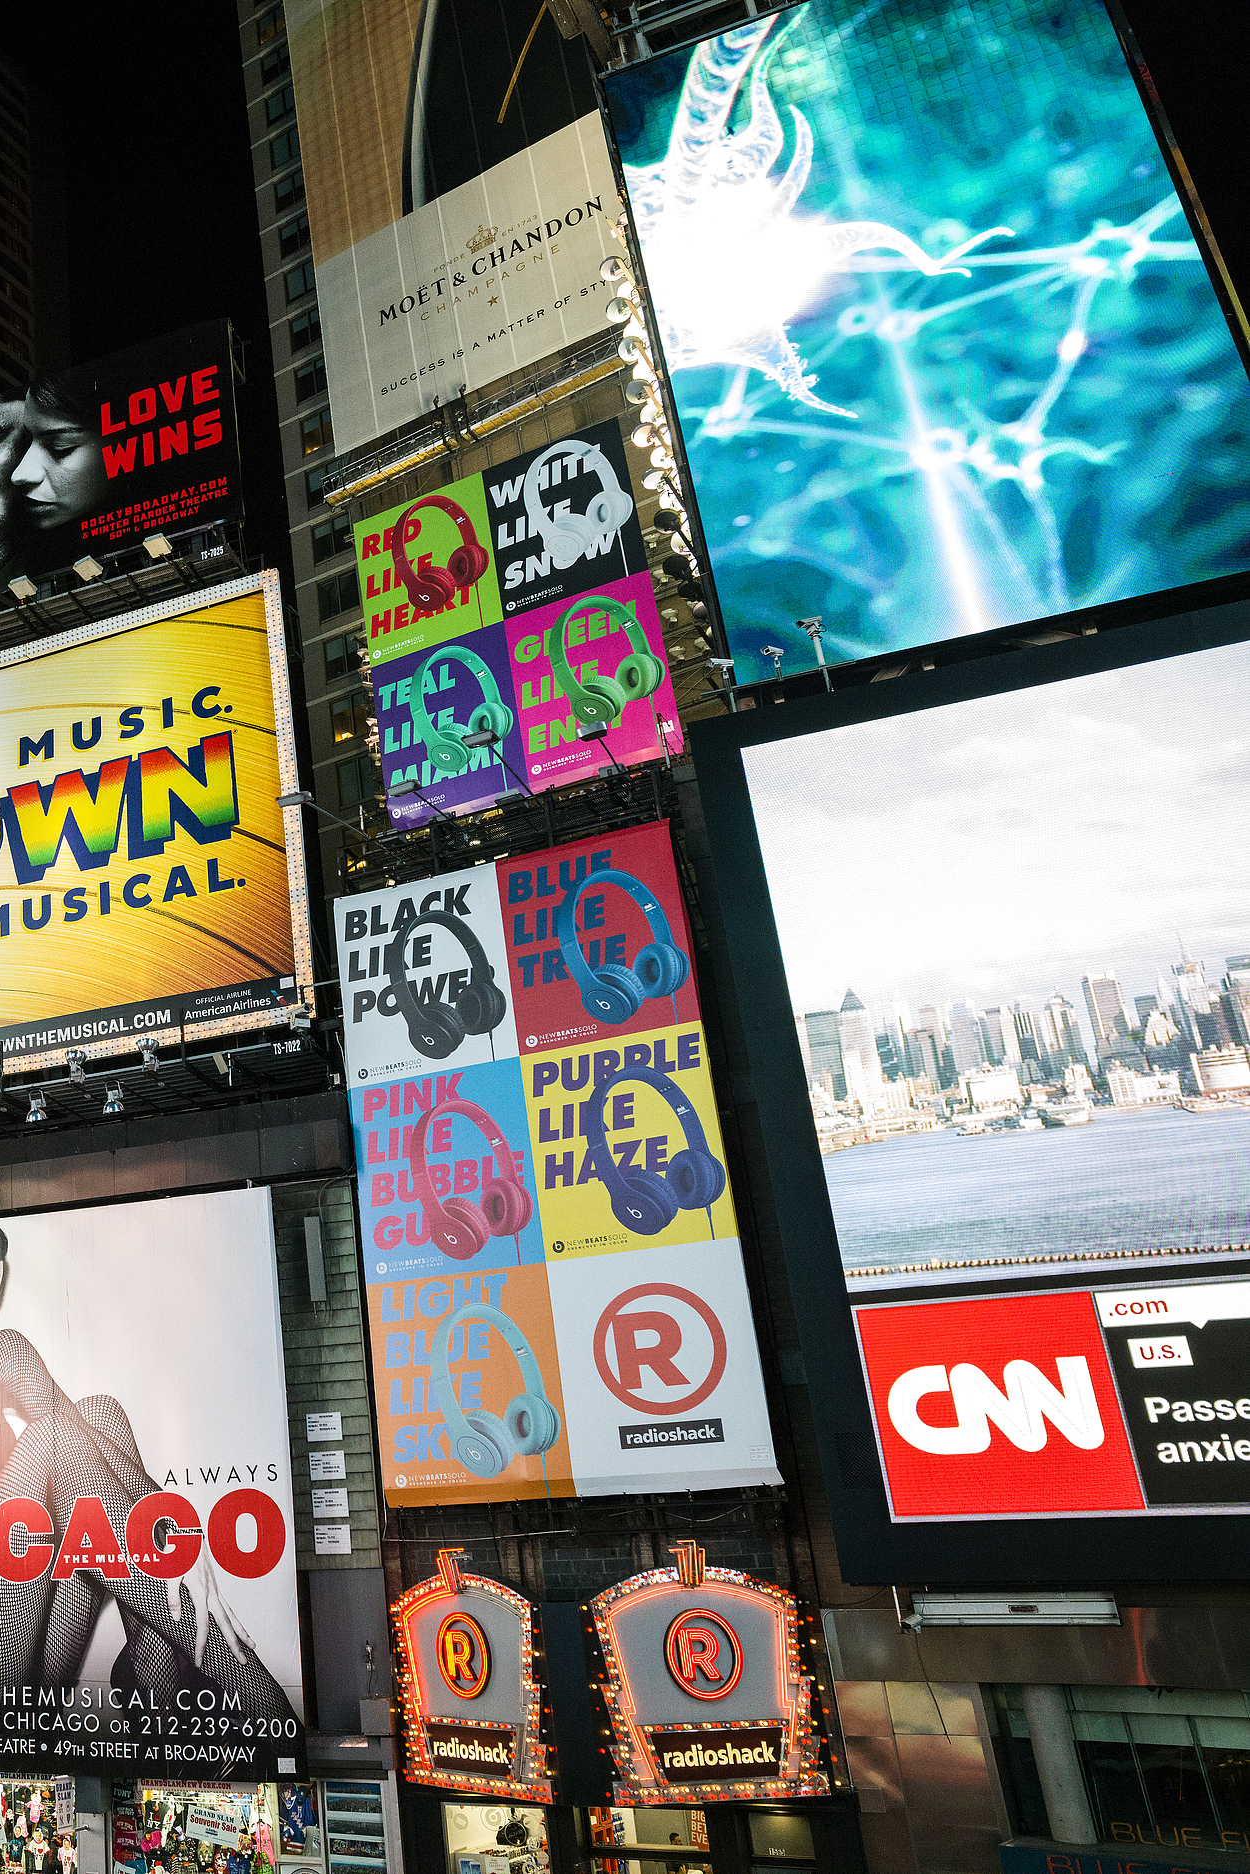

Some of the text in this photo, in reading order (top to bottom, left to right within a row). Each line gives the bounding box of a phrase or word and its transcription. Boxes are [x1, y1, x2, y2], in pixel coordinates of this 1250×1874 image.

[377, 195, 604, 327] MOËT & CHANDON
[420, 244, 561, 322] CHAMPAGNE
[381, 358, 446, 396] SUCCESS
[452, 349, 465, 360] IS
[472, 341, 481, 351] A
[487, 308, 546, 343] MATTER
[554, 295, 571, 309] OF
[100, 365, 219, 437] LOVE
[103, 409, 223, 480] WINS
[81, 477, 227, 531] ROCKYBROADWAY.COM
[91, 487, 229, 537] WINTER GARDEN THEATRE
[143, 506, 200, 530] BROADWAY
[378, 663, 456, 711] TEAL
[18, 685, 234, 767] MUSIC.
[507, 849, 612, 905] BLUE
[344, 883, 472, 943] BLACK
[185, 997, 271, 1020] American Airlines
[195, 989, 252, 1005] OFFICIAL AIRLINE
[353, 966, 474, 1024] POWE
[273, 1039, 301, 1056] TS-7022
[532, 1032, 701, 1098] PURPLE
[363, 1072, 464, 1122] PINK
[371, 1150, 525, 1208] BUBBLE
[544, 1135, 668, 1190] HAZE
[373, 1211, 432, 1251] GU
[381, 1273, 508, 1323] LIGHT
[1108, 1298, 1169, 1318] .com
[385, 1323, 490, 1369] BLUE
[1139, 1344, 1182, 1361] U.S.
[887, 1355, 1105, 1456] CNN
[1144, 1396, 1250, 1424] Passe
[625, 1425, 716, 1446] radioshack
[1156, 1433, 1250, 1464] anxie
[163, 1463, 280, 1488] ALWAYS
[64, 1553, 161, 1564] THE MUSICAL
[110, 1720, 131, 1734] OR
[140, 1716, 297, 1739] 212-239-6200
[54, 1741, 85, 1758] 49TH
[88, 1743, 141, 1759] STREET
[145, 1746, 160, 1760] AT
[164, 1745, 256, 1763] BROADWAY
[432, 1736, 510, 1765] radioshack
[663, 1740, 777, 1768] radioshack
[222, 1821, 237, 1834] Sale
[691, 1810, 706, 1822] BIG
[1111, 1821, 1201, 1849] BLUE
